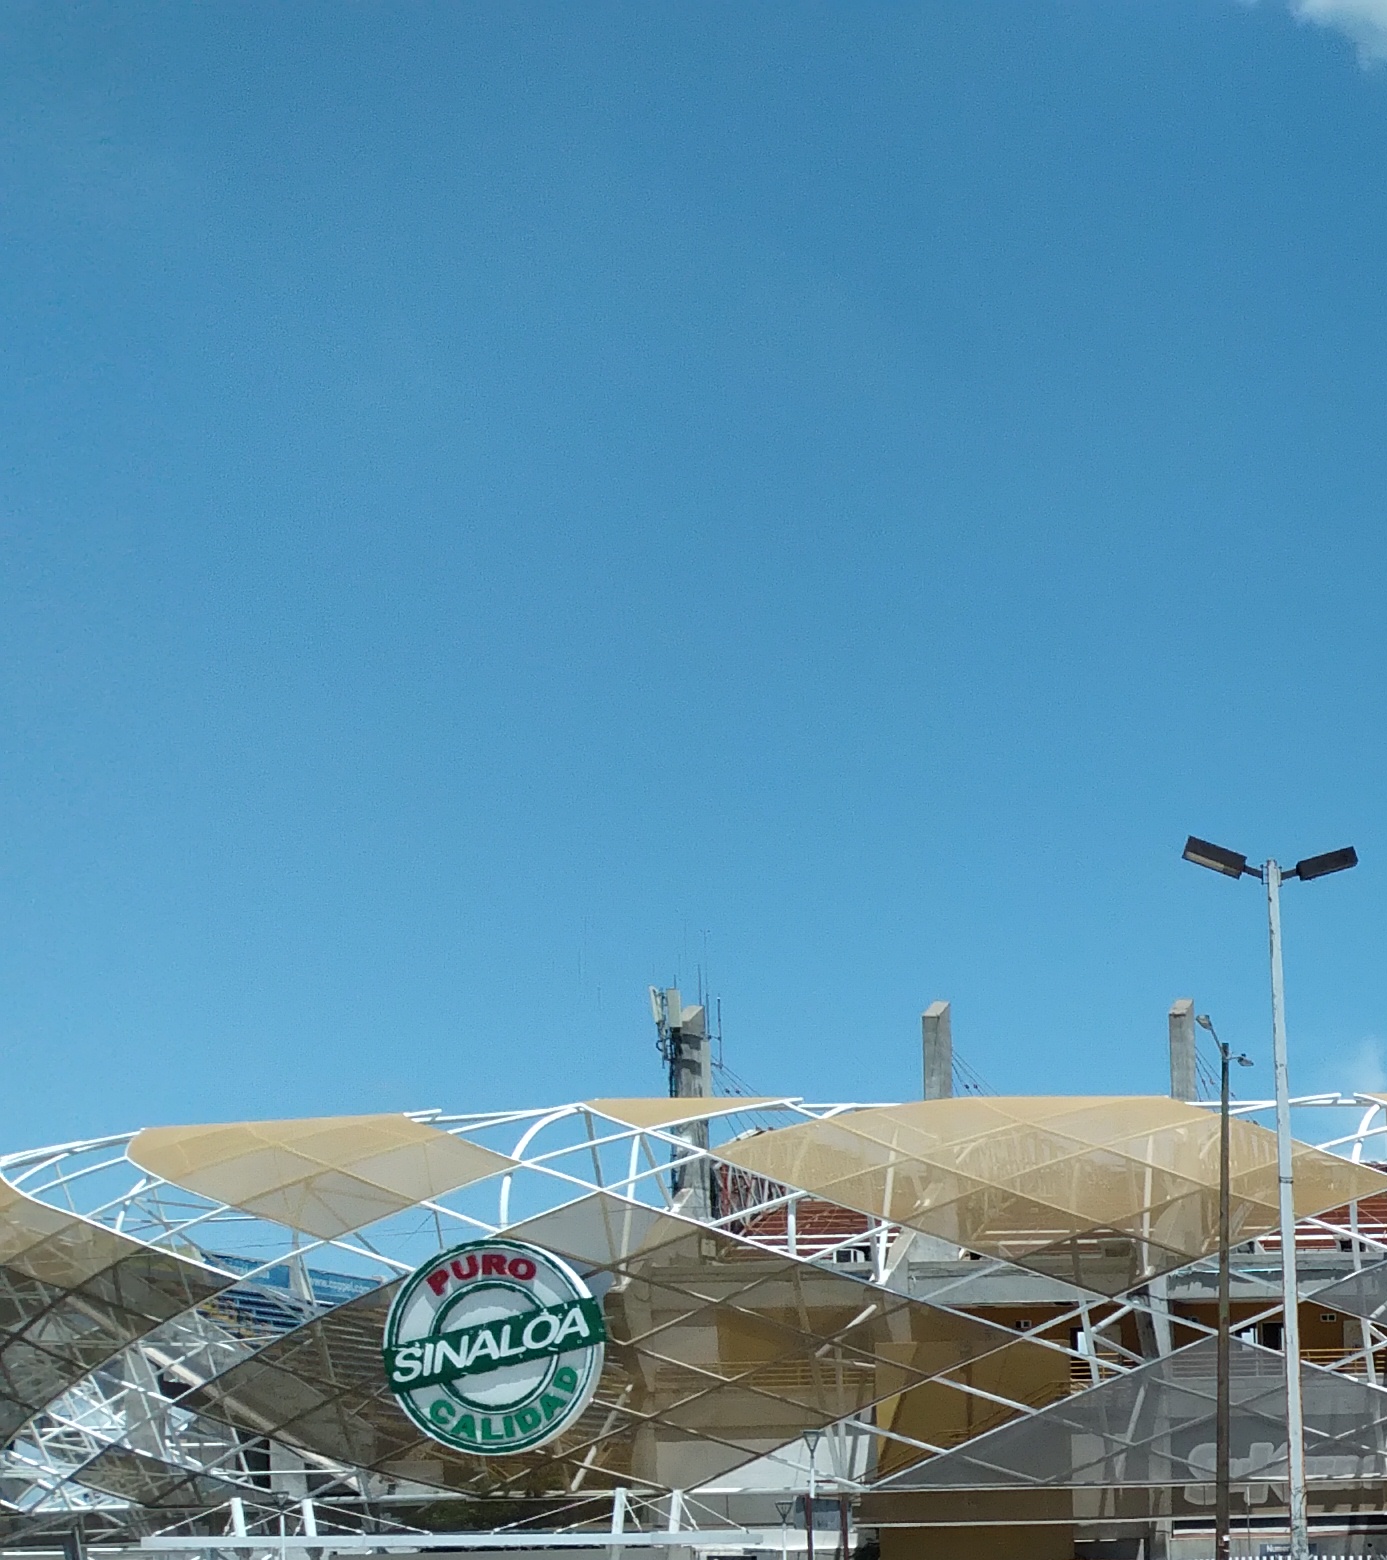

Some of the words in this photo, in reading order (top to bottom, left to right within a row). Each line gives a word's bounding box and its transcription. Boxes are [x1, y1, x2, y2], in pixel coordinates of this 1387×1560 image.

[425, 1253, 538, 1297] PURO
[392, 1307, 591, 1383] SINALOA
[428, 1365, 580, 1441] CALIDAD
